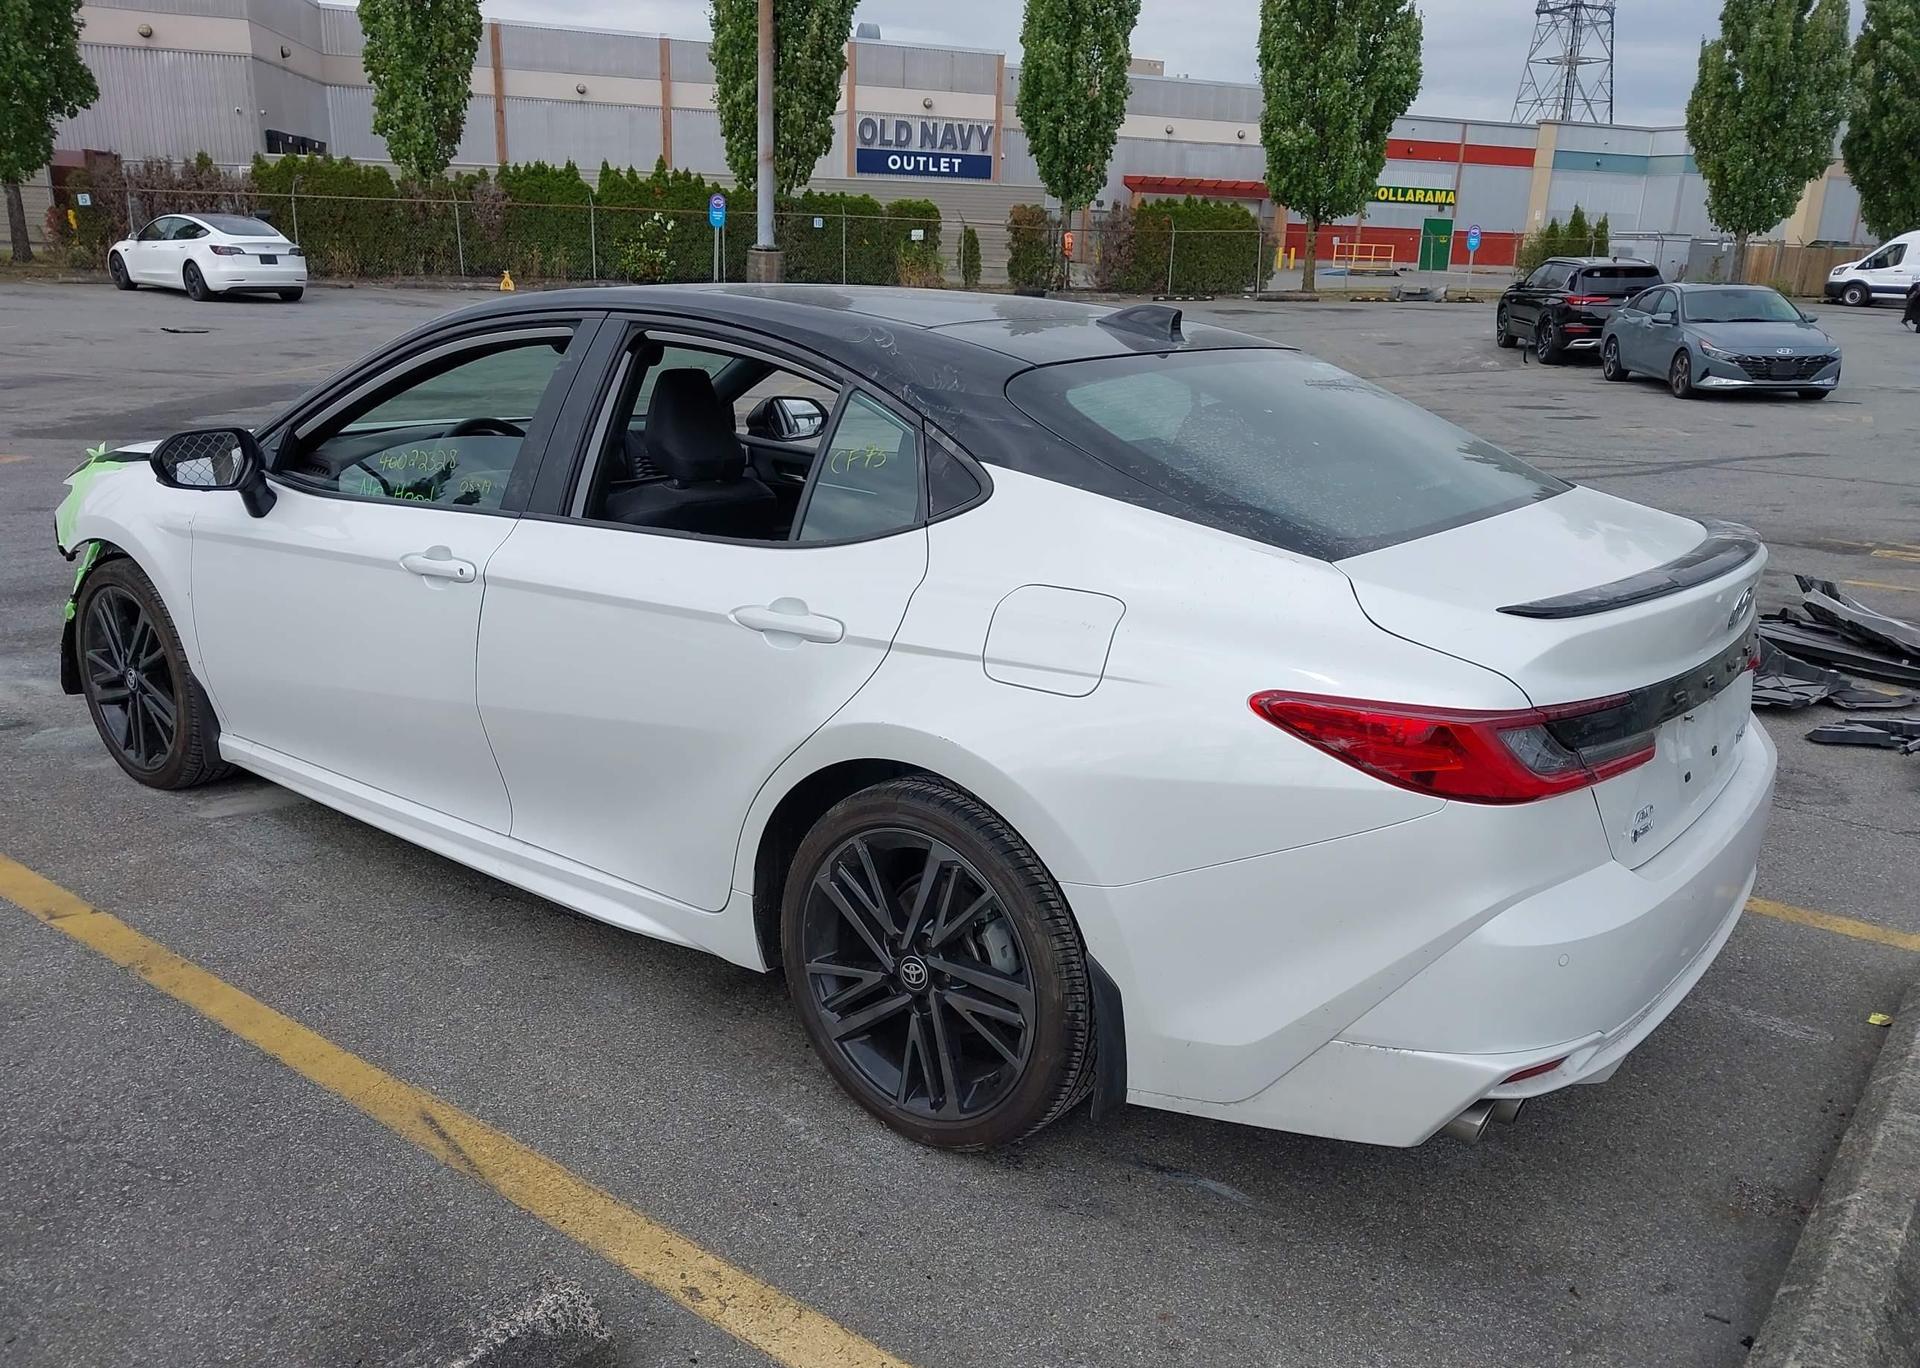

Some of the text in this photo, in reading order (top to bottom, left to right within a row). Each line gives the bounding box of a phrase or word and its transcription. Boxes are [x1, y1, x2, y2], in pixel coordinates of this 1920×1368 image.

[858, 117, 994, 152] OLD NAVY
[887, 155, 962, 173] OUTLET
[1375, 187, 1456, 204] OLLARAMA
